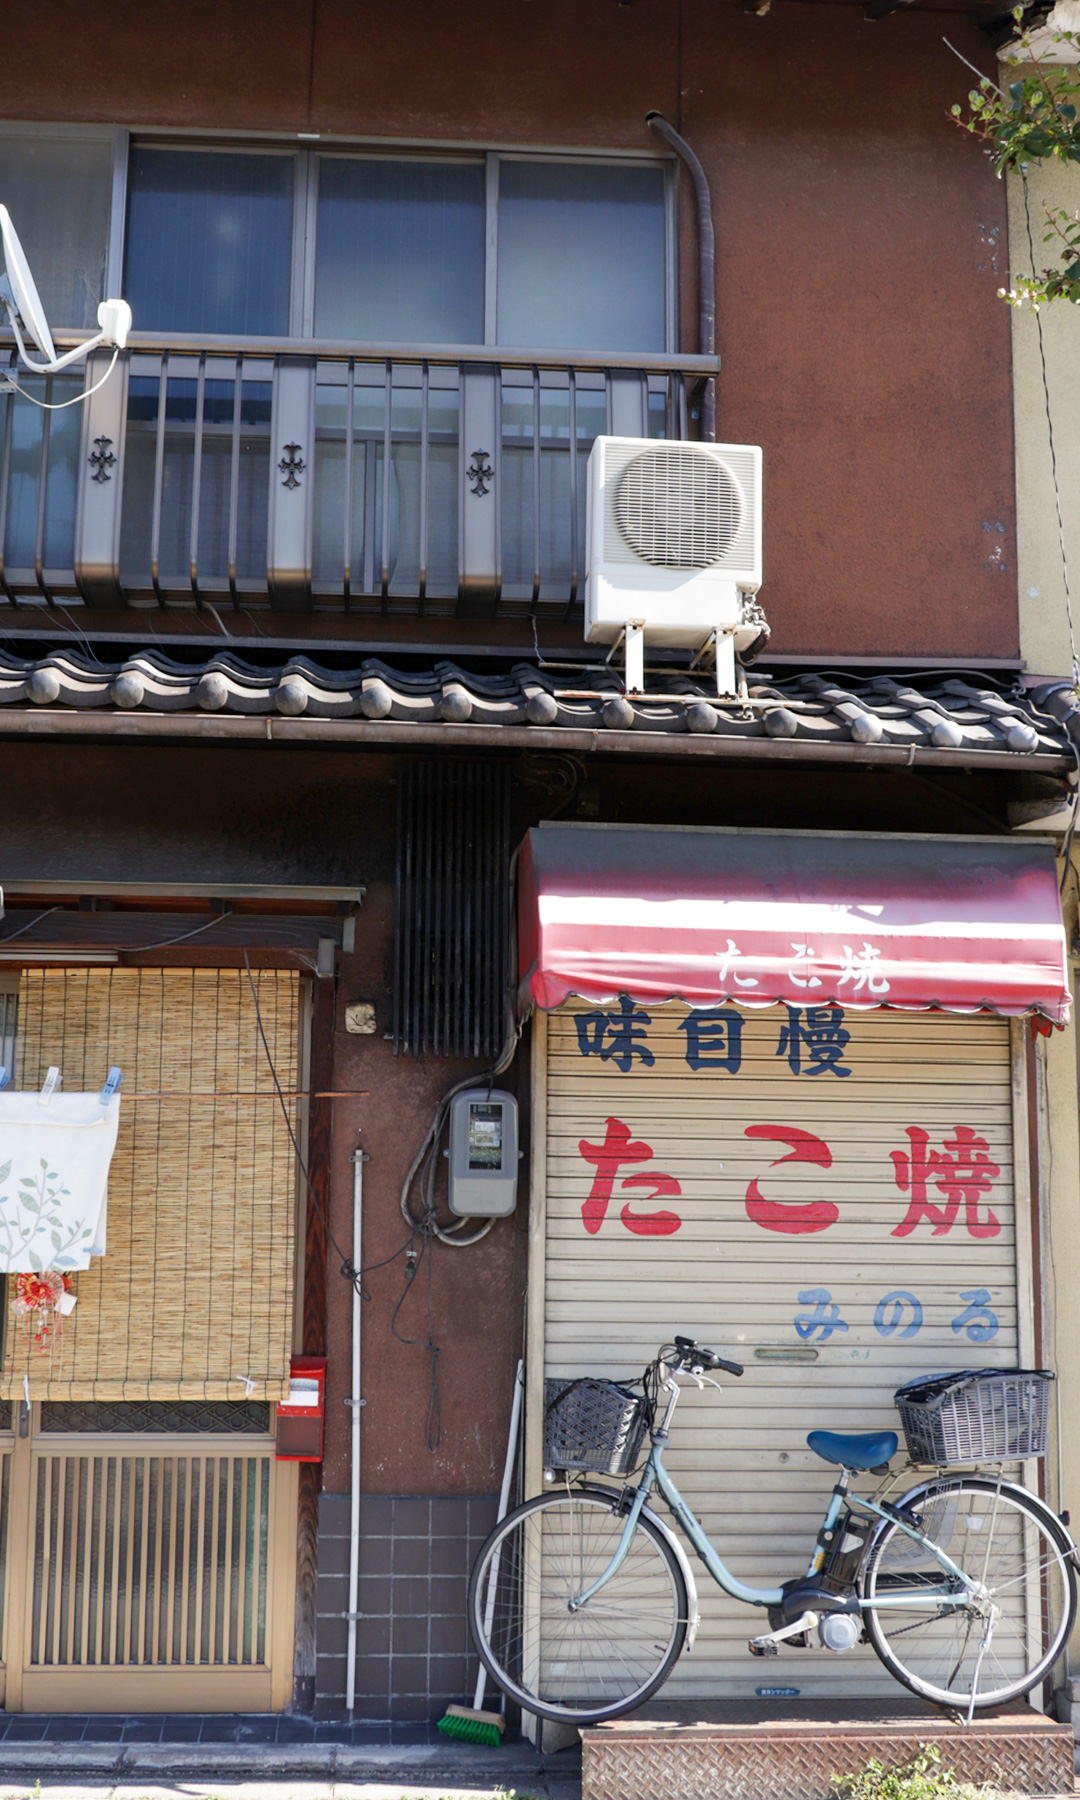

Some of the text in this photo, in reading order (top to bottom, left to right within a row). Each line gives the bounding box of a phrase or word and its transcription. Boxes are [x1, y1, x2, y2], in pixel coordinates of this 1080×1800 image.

[715, 938, 891, 993] たこ焼
[573, 997, 853, 1077] 味自慢
[578, 1117, 1002, 1238] たこ焼
[794, 1288, 999, 1342] みのる
